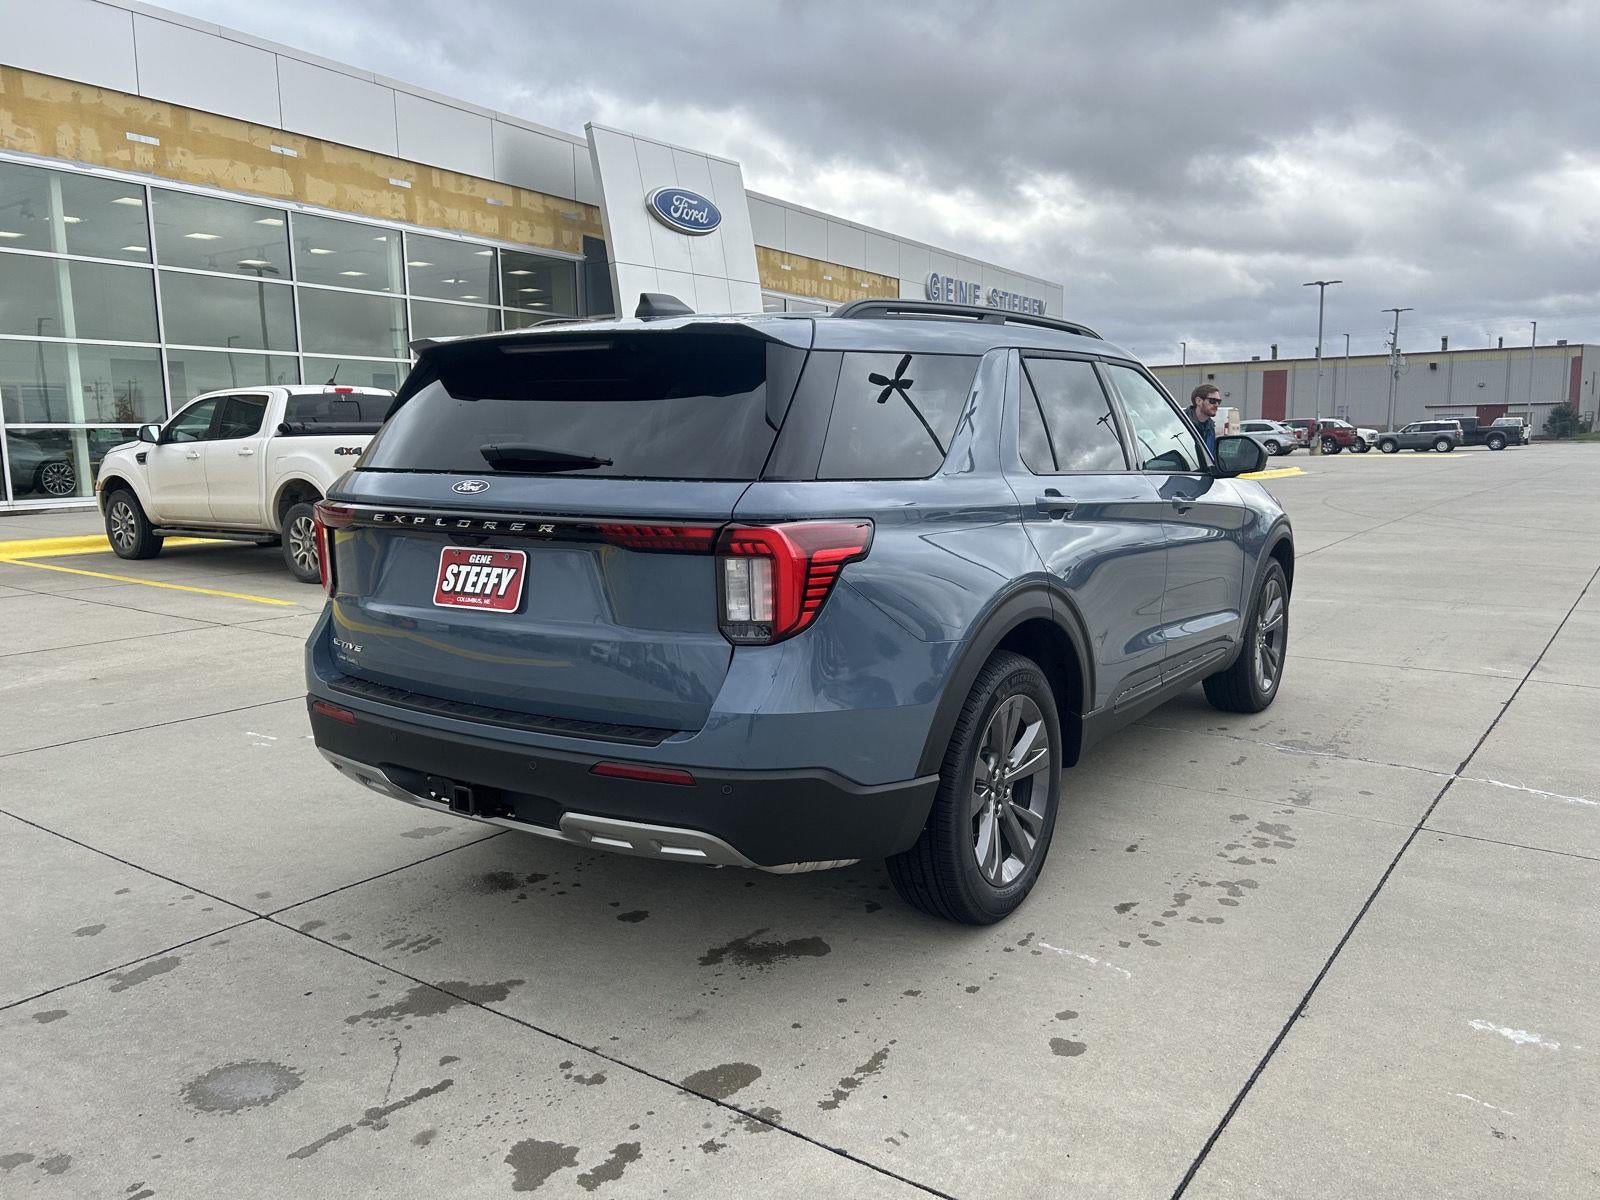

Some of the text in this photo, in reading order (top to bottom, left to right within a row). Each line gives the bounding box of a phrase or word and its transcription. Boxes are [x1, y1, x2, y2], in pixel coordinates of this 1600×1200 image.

[670, 195, 709, 224] Ford
[926, 272, 981, 304] GENE
[457, 480, 483, 491] Ford
[373, 514, 555, 533] EXPLORER
[469, 554, 493, 565] GENE
[441, 564, 517, 597] STEFFY
